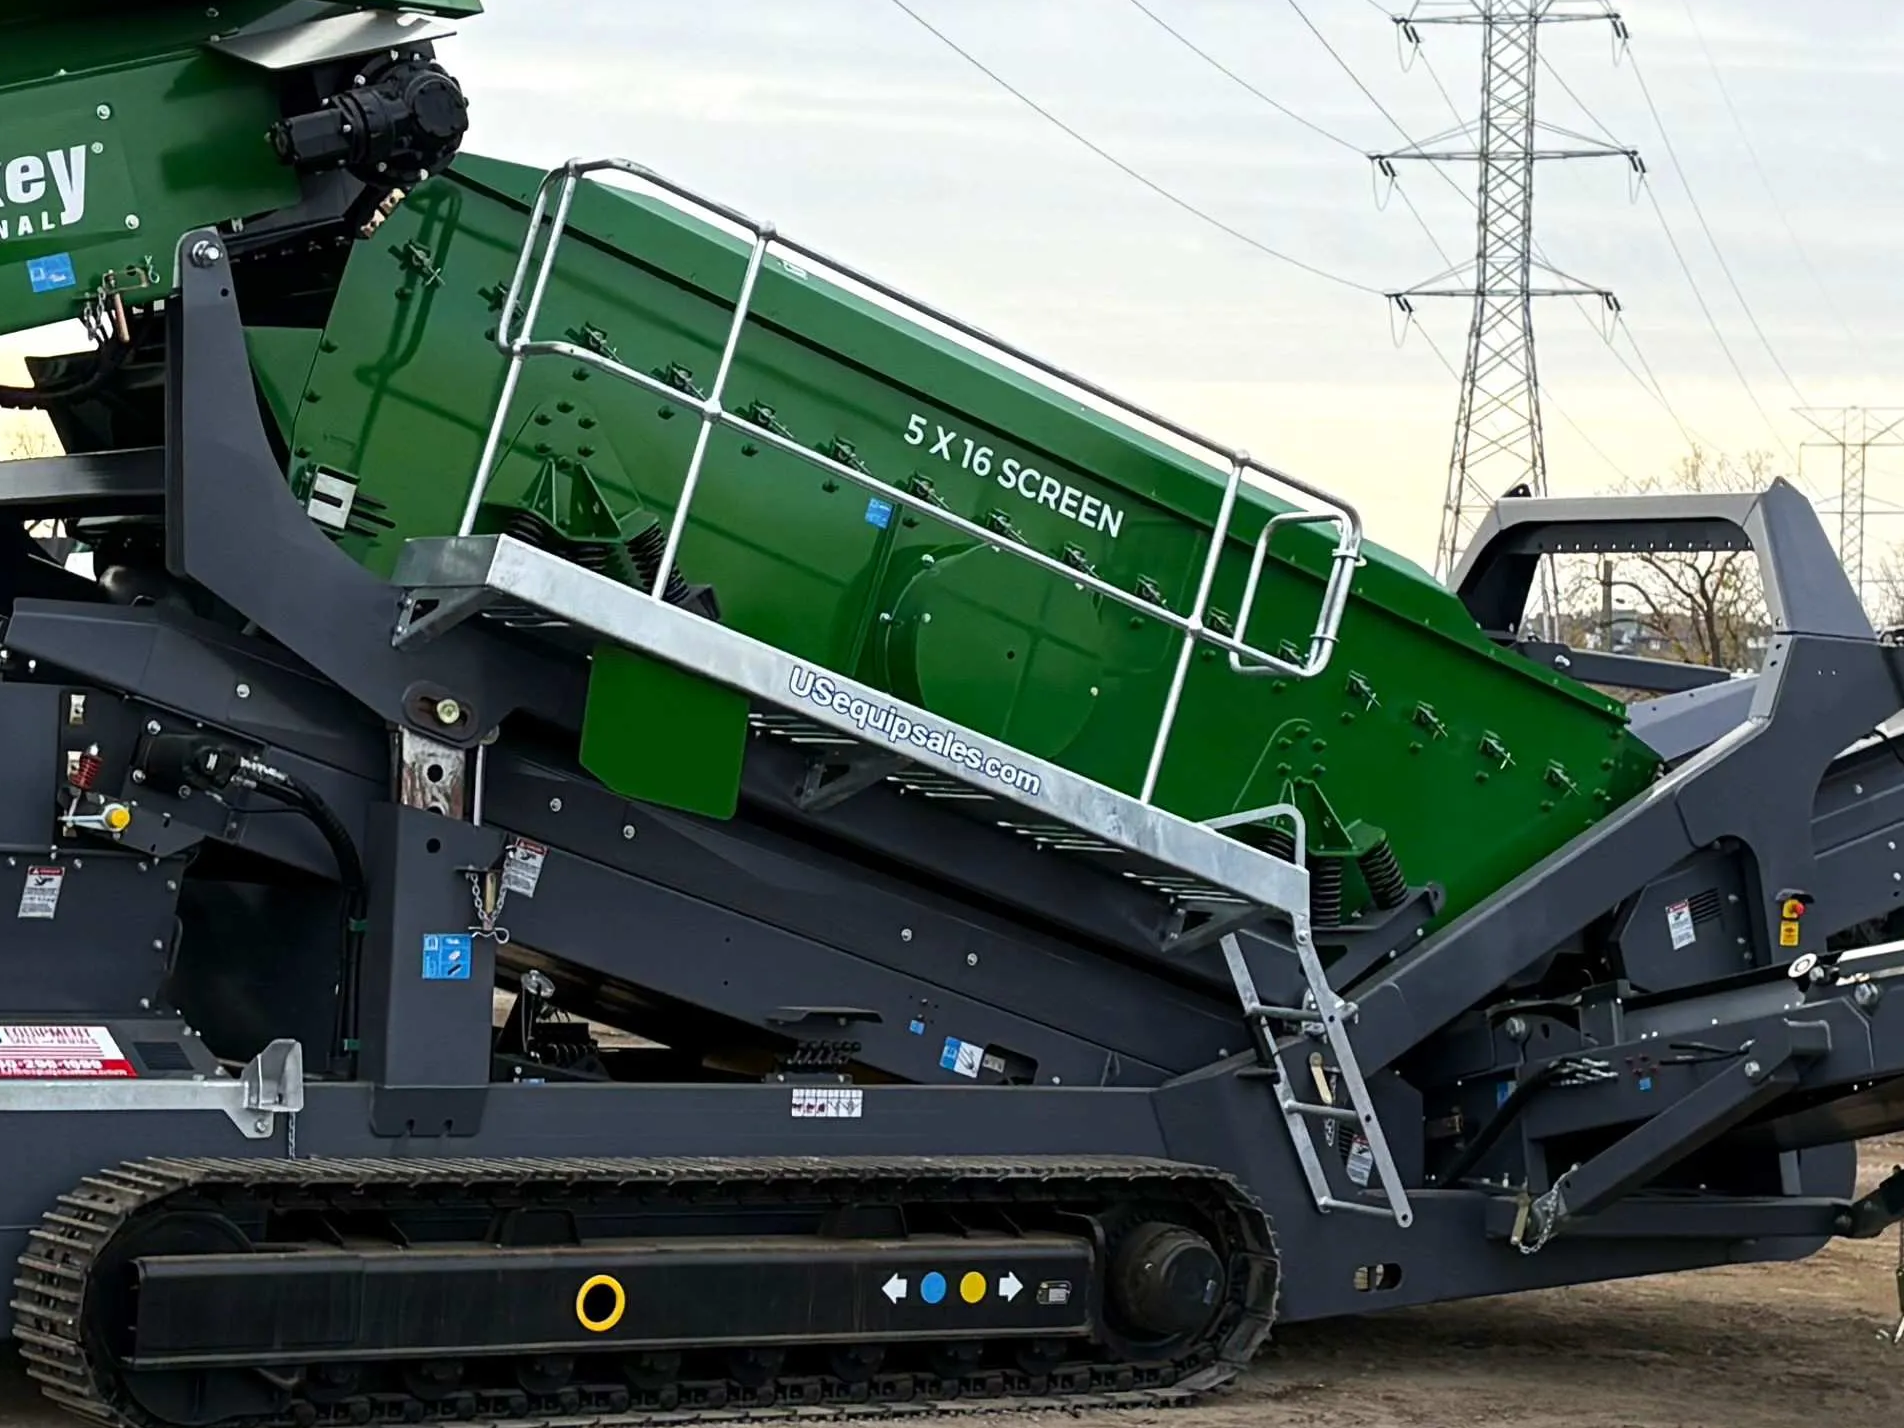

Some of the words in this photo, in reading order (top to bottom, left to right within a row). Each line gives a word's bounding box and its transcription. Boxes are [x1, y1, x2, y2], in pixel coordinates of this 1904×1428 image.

[903, 413, 928, 445] 5
[928, 425, 957, 461] X
[961, 438, 994, 476] 16
[997, 457, 1124, 538] SCREEN
[789, 665, 1041, 796] USequipsales.com
